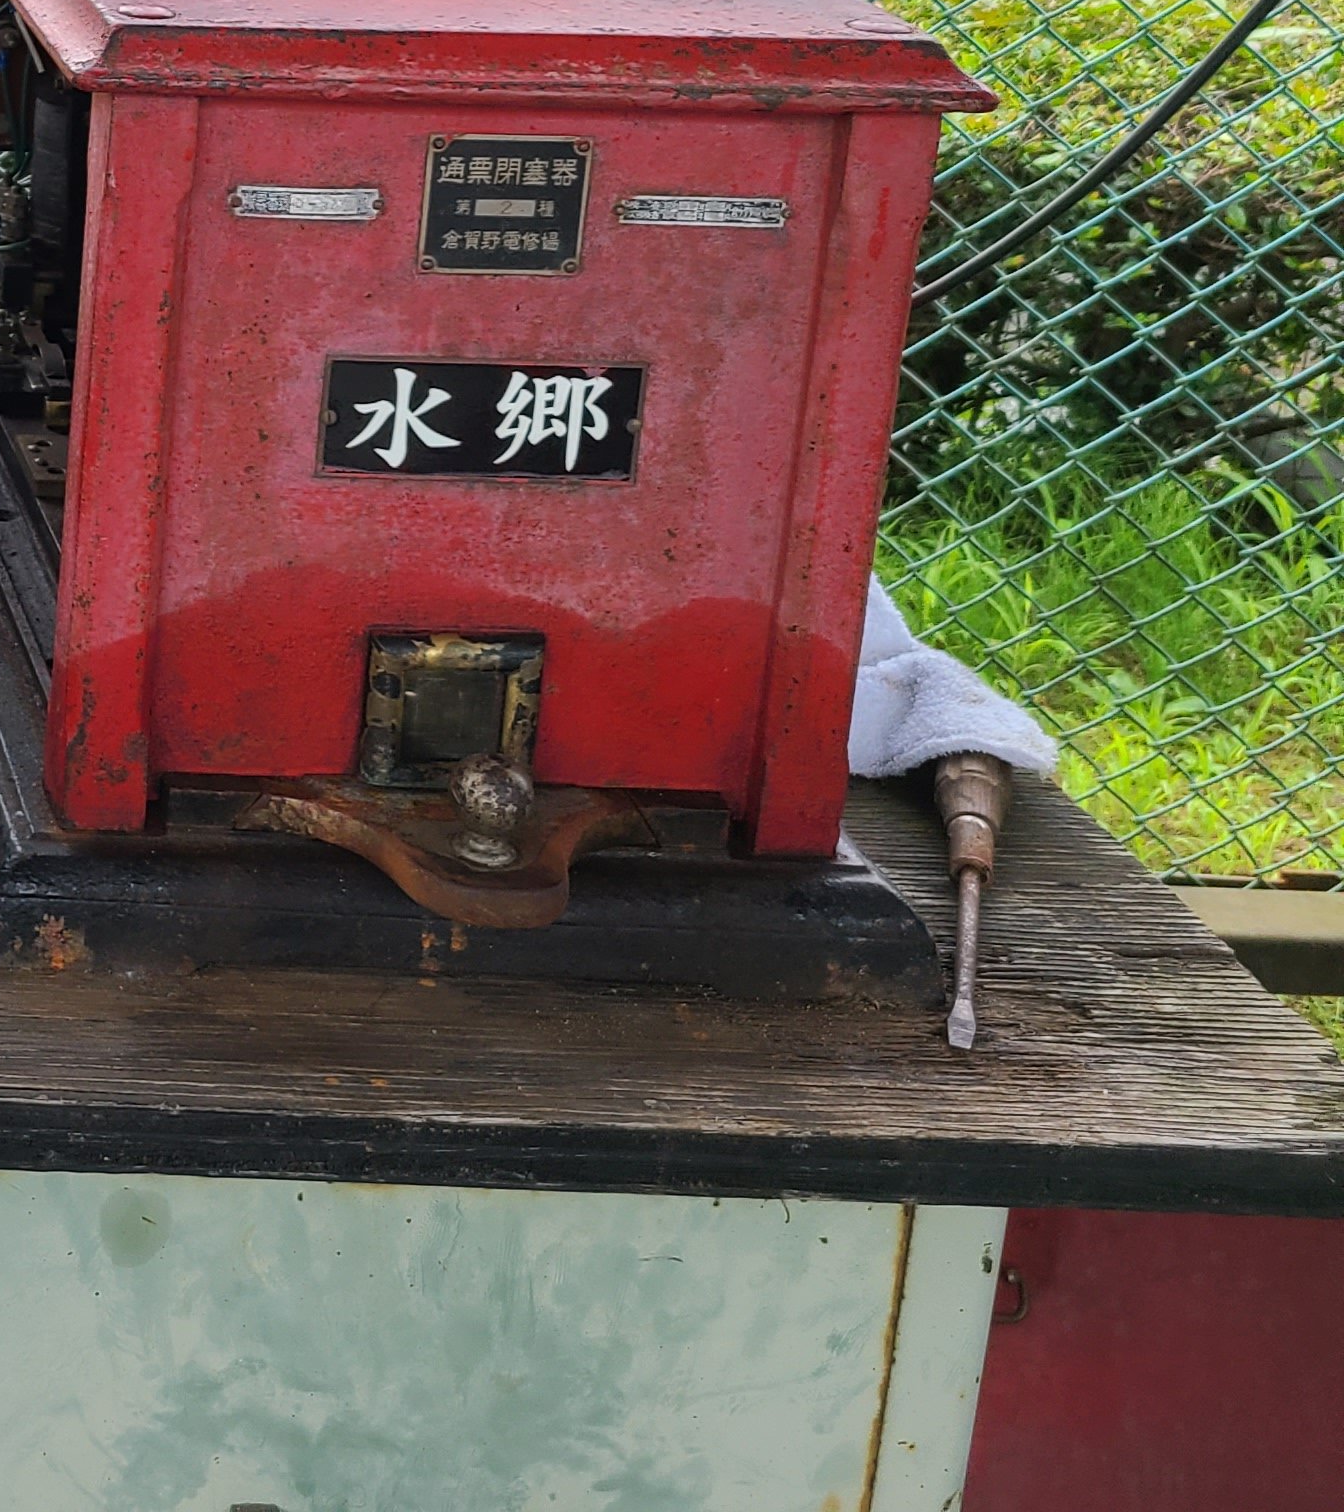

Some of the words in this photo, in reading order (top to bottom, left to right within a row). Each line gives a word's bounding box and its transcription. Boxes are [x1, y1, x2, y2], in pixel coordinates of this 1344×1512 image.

[437, 156, 578, 186] 通票閉塞器
[345, 368, 614, 472] 水郷
